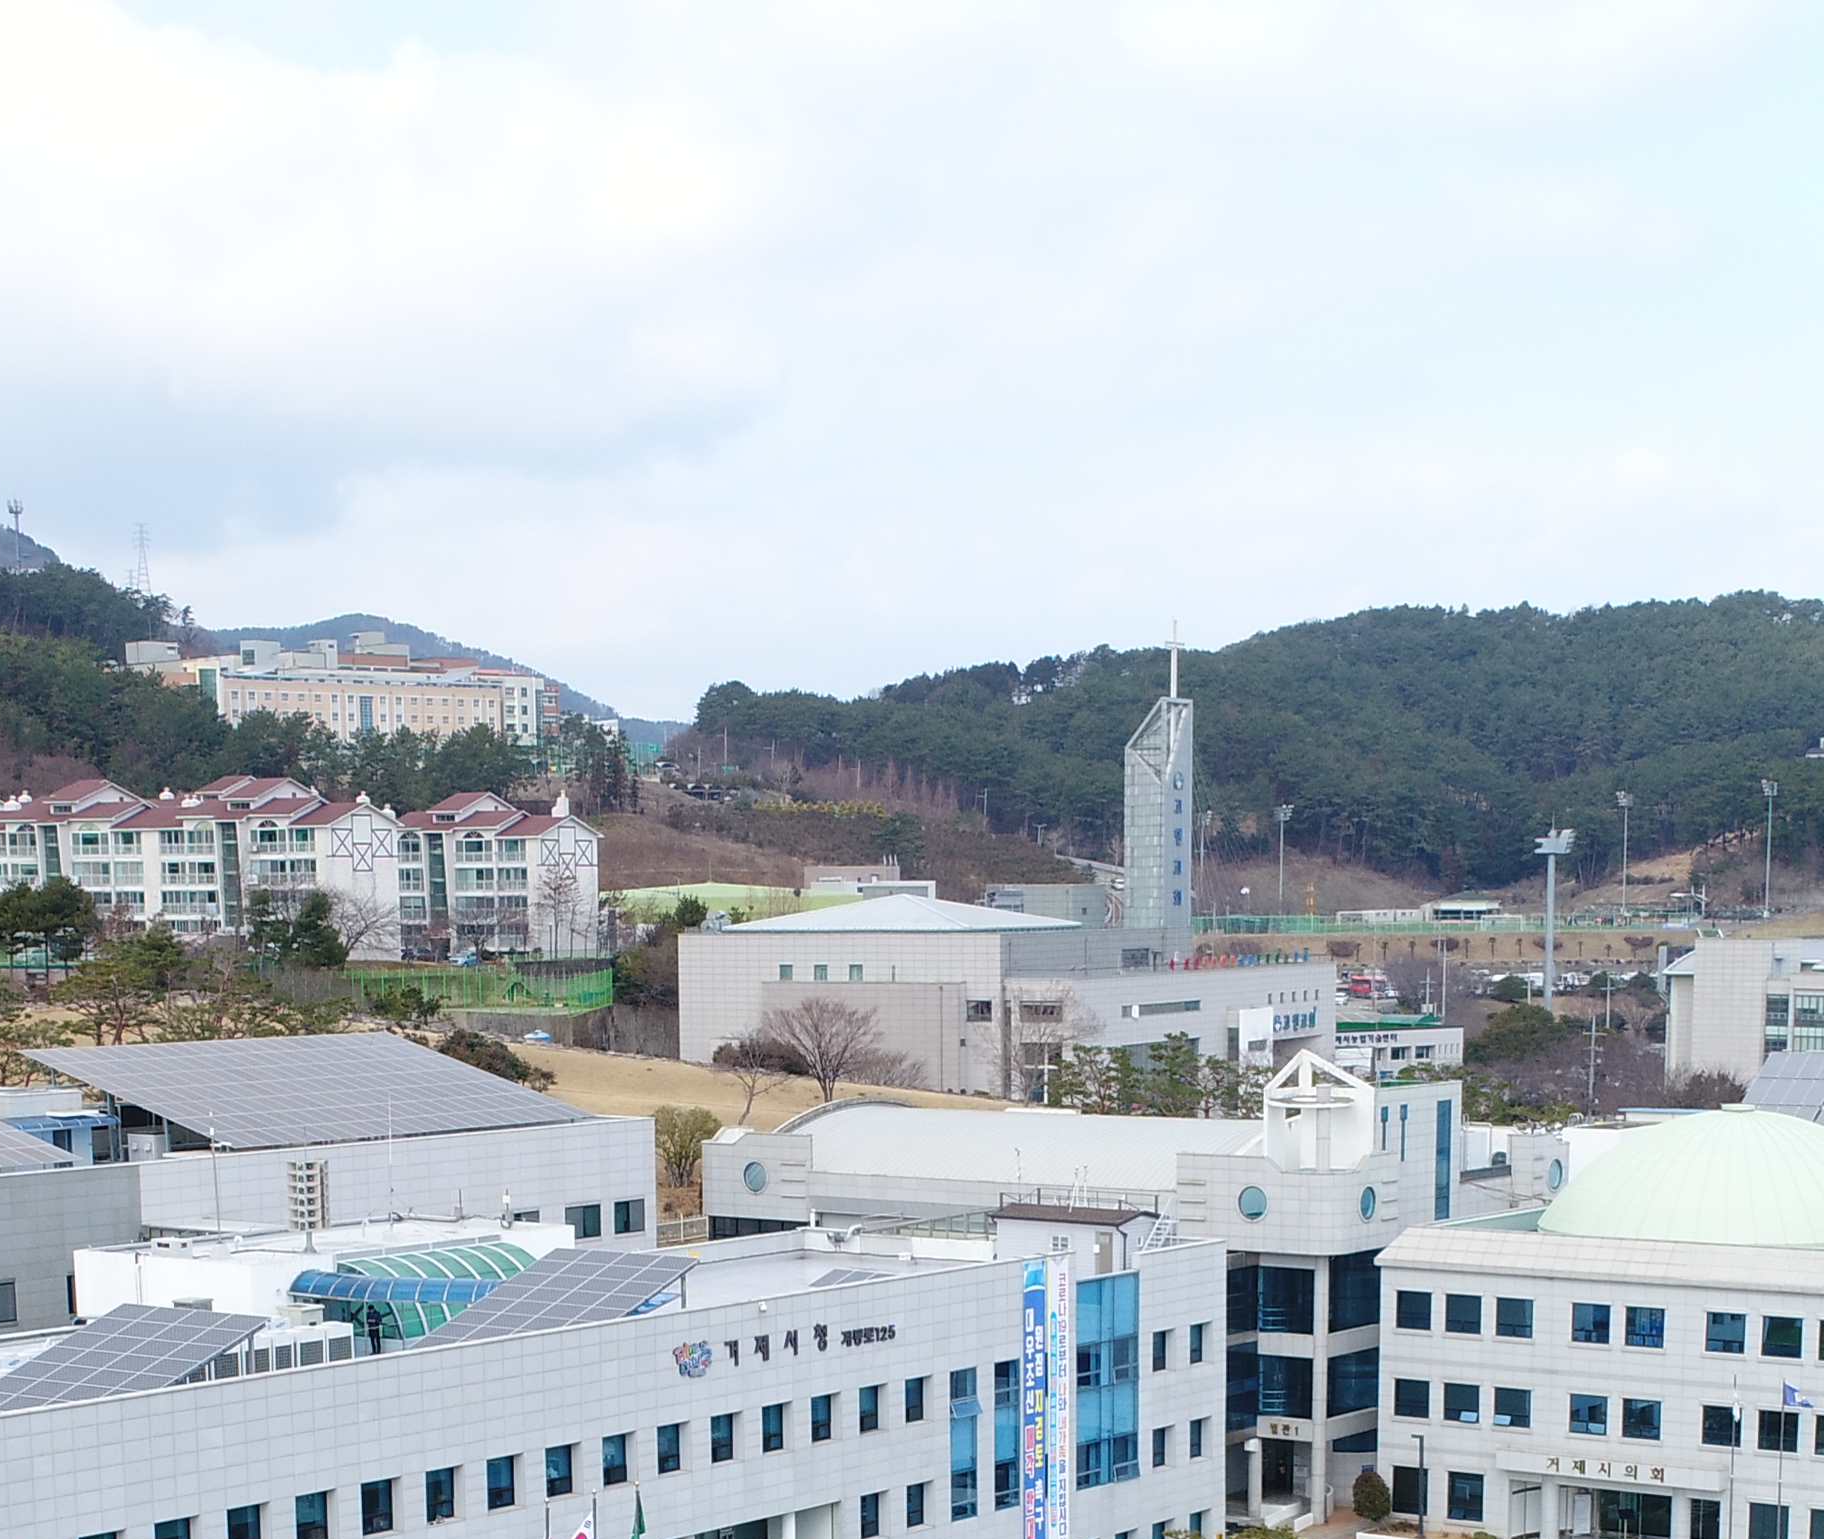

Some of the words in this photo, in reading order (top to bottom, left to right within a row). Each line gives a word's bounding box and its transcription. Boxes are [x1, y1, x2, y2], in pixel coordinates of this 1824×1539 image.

[1057, 1272, 1068, 1378] 코로나19로부터
[724, 1323, 829, 1367] 거제시청
[840, 1324, 897, 1348] 계룡로125
[1057, 1383, 1068, 1412] 나와
[1546, 1456, 1667, 1484] 거제시의회
